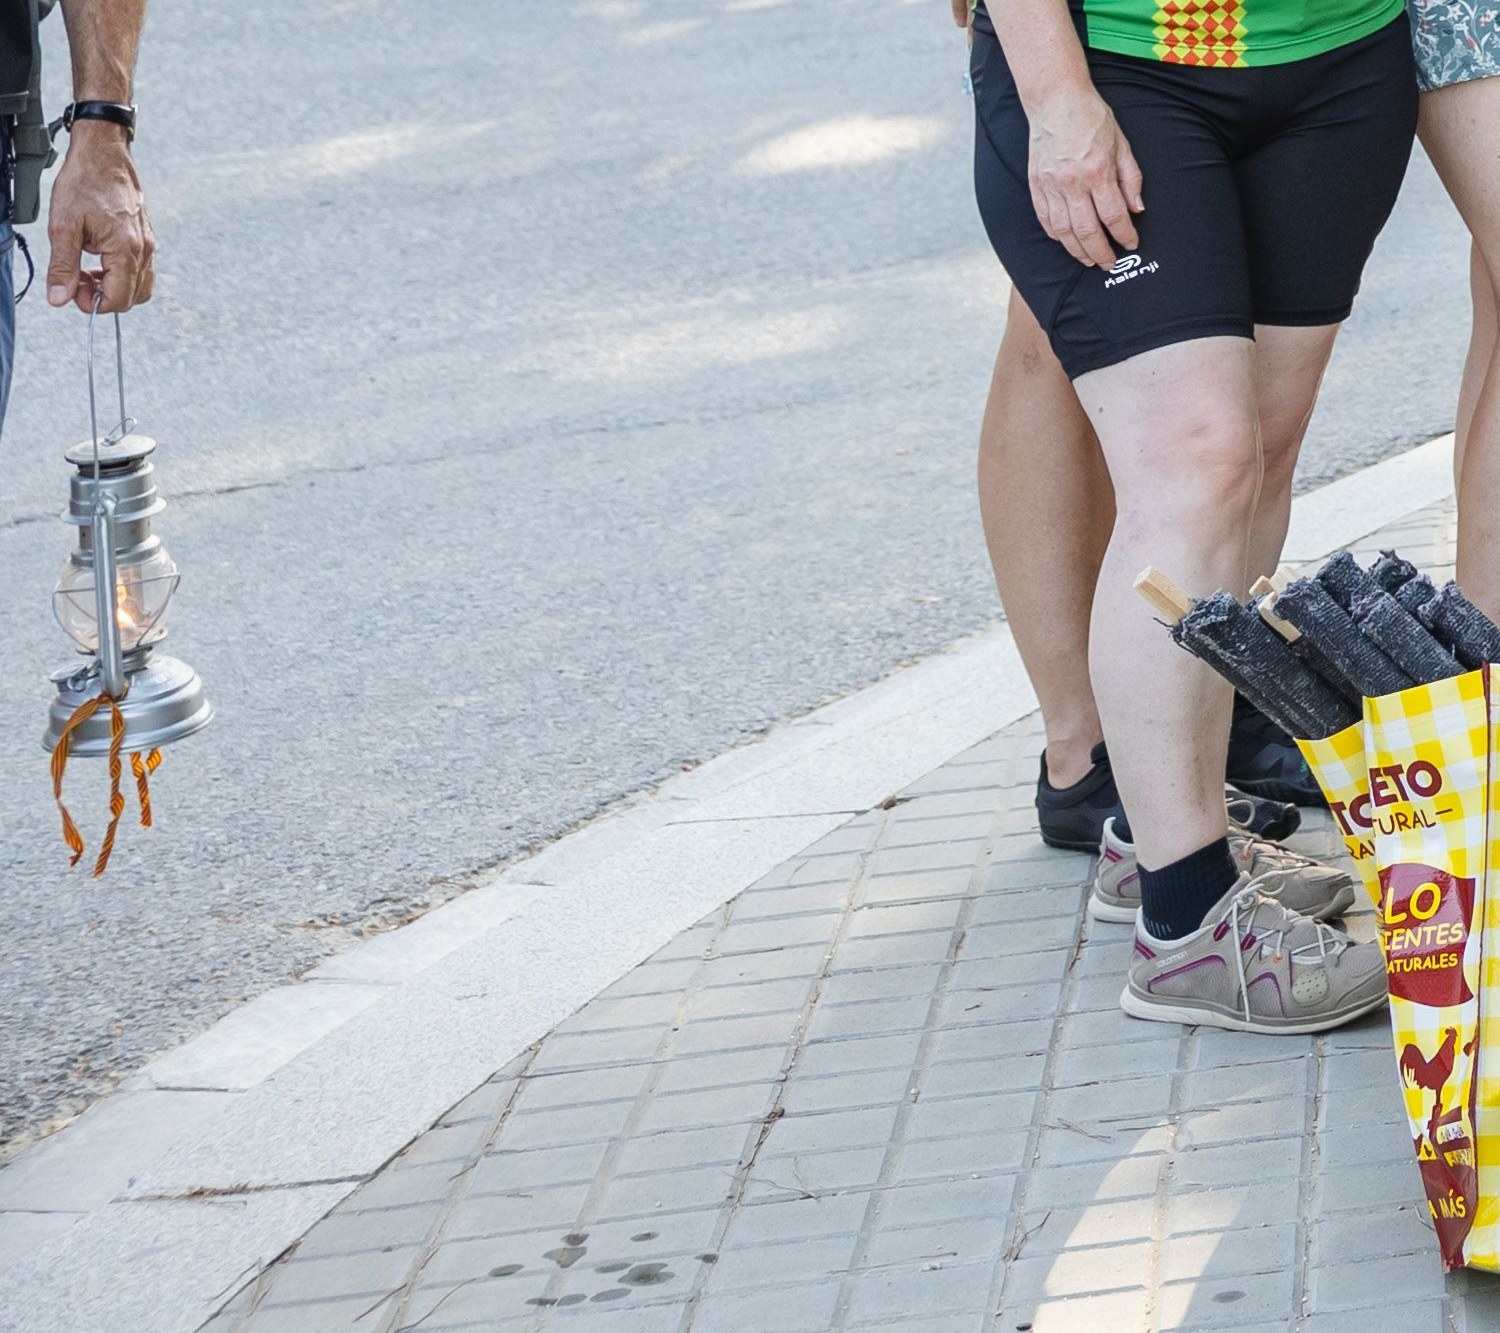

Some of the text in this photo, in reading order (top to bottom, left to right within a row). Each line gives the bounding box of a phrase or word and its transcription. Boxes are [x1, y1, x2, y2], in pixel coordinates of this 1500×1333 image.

[1369, 760, 1443, 808] ETO
[1384, 881, 1442, 926] LO
[1386, 952, 1460, 976] ATURALES
[1439, 1188, 1467, 1220] MÁS
